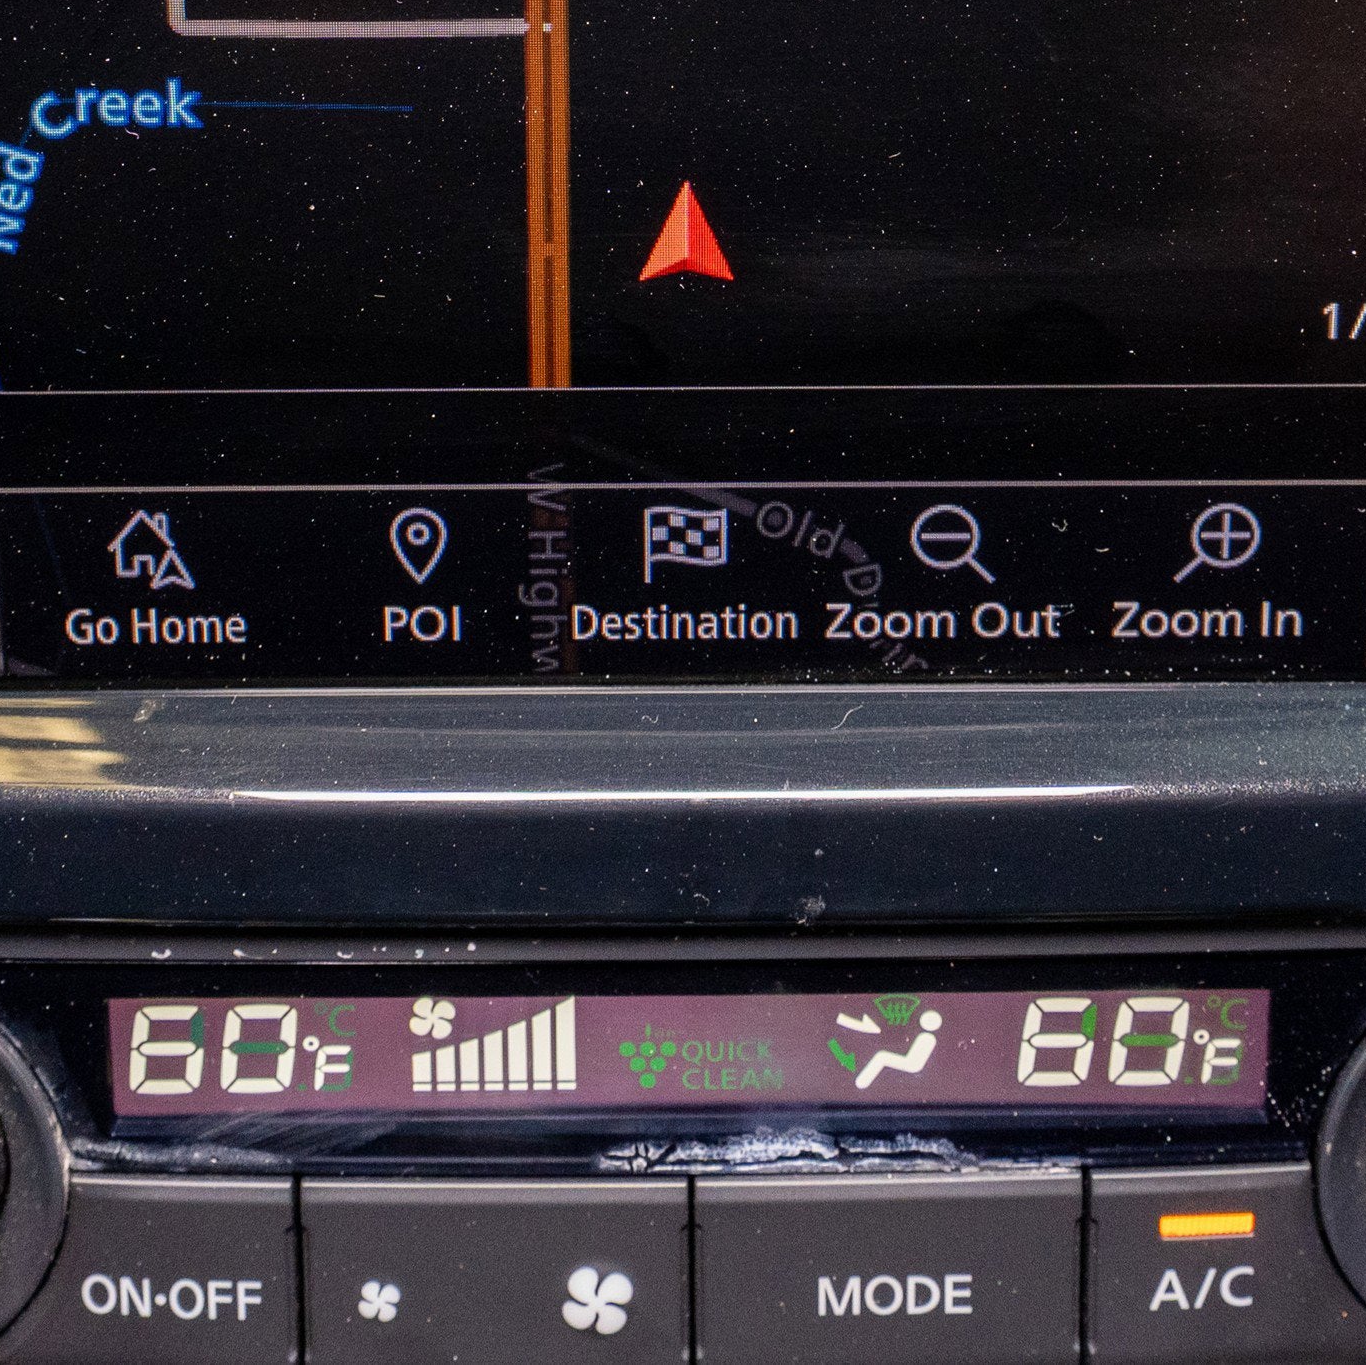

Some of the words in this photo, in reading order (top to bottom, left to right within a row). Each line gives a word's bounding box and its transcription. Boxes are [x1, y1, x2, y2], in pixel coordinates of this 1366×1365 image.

[32, 77, 204, 138] Creek
[65, 609, 120, 646] Go
[131, 608, 248, 645] Home
[384, 605, 462, 642] POI
[571, 604, 799, 641] Destination
[824, 603, 956, 639] Zoom
[971, 602, 1062, 639] Out
[1111, 601, 1244, 638] Zoom
[1260, 601, 1304, 638] In
[682, 1040, 772, 1066] QUICK
[682, 1067, 784, 1090] CLEAN
[817, 1274, 974, 1318] MODE
[1148, 1264, 1255, 1312] A/C
